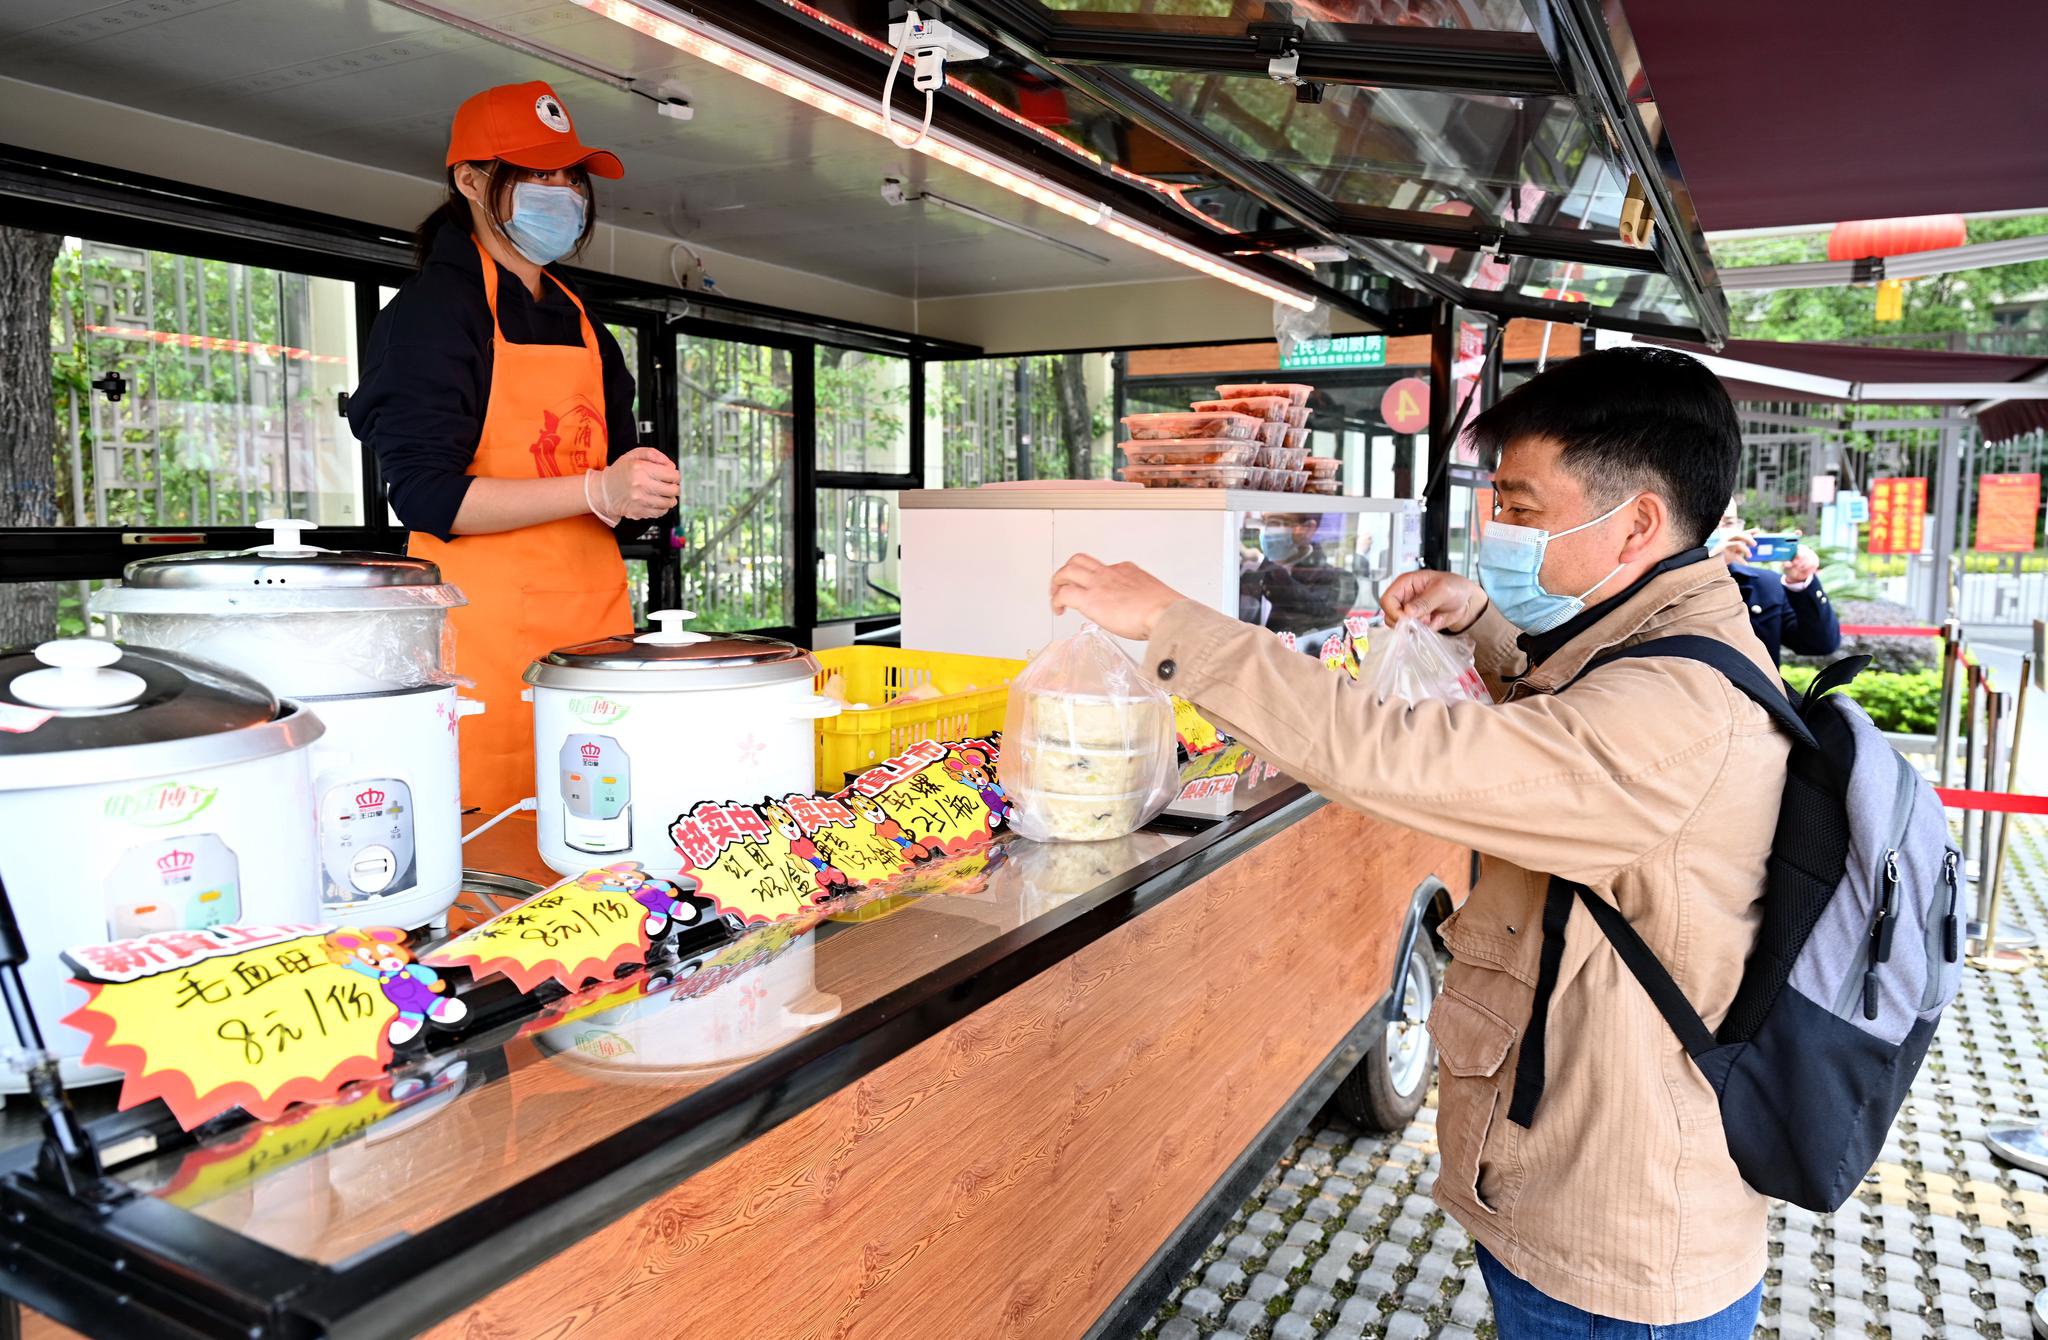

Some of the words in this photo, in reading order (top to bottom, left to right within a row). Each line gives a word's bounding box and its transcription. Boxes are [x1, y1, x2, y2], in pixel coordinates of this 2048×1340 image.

[782, 796, 855, 832] 卖中
[520, 899, 629, 948] 8元/份
[176, 950, 328, 1008] 毛血旺
[217, 982, 374, 1065] 8元/份
